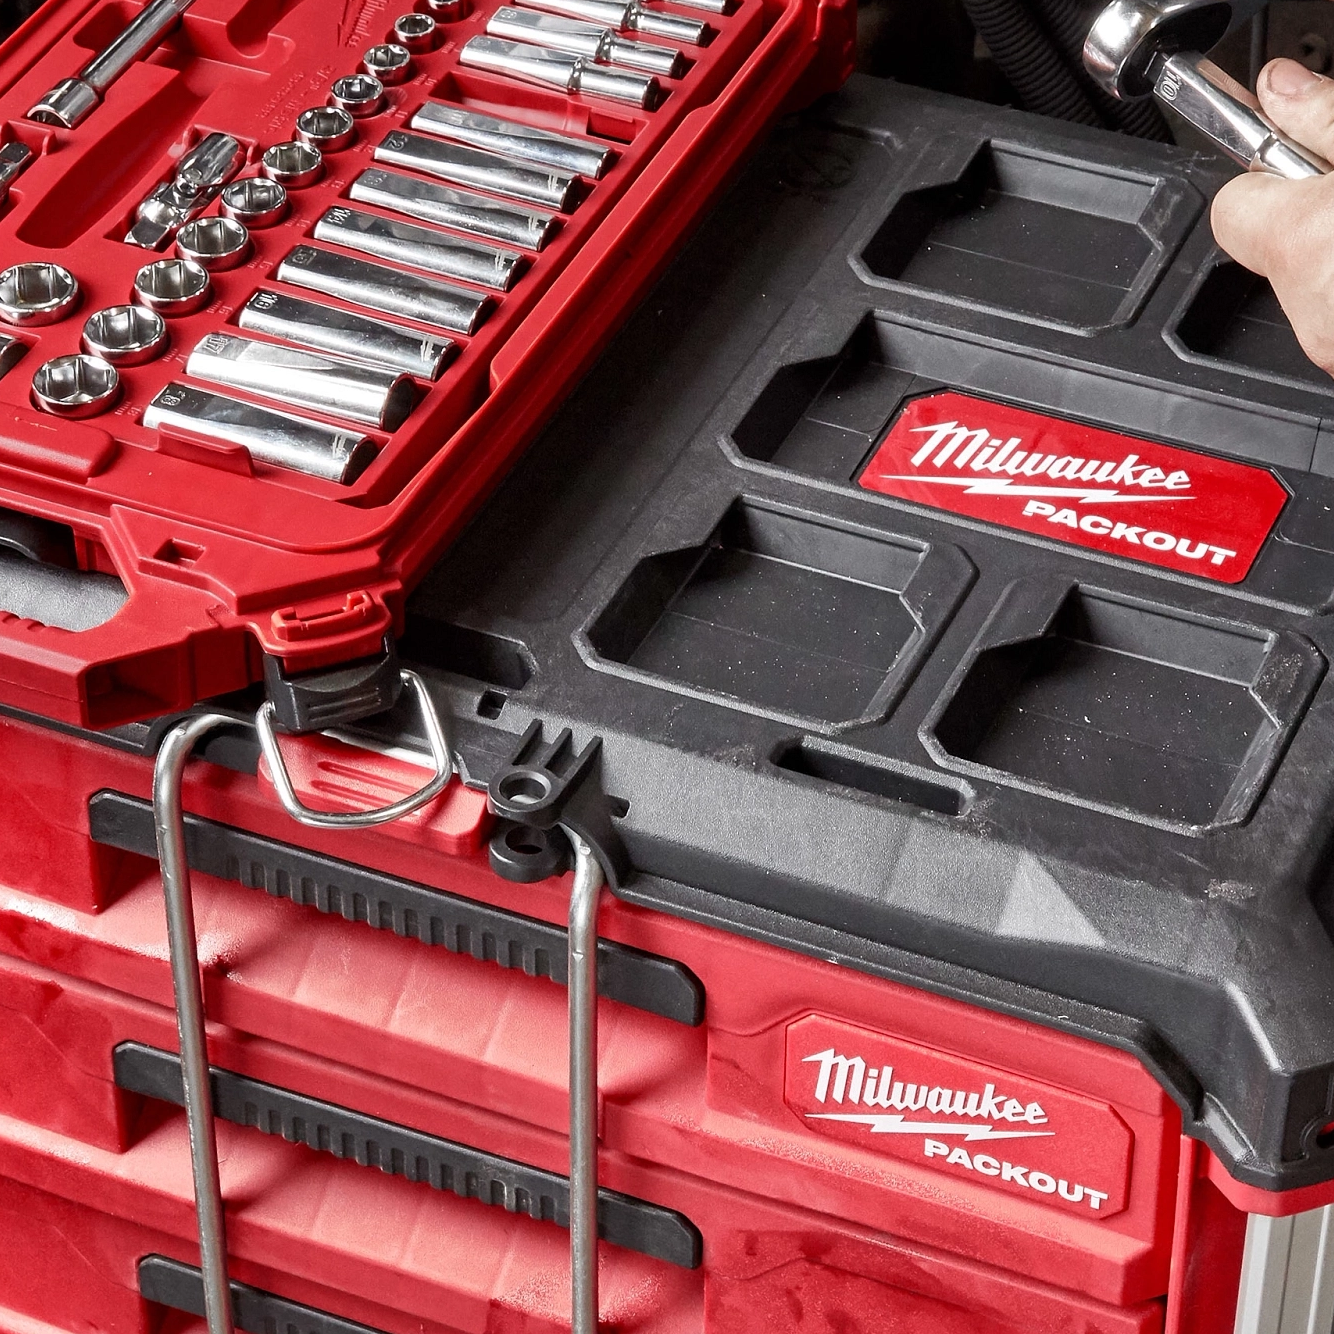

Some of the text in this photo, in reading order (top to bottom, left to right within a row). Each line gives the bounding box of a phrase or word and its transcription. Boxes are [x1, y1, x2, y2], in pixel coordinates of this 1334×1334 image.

[908, 420, 1193, 491] Milwaukee
[1022, 499, 1238, 567] PACKOUT
[801, 1047, 1050, 1125] Milwaukee
[923, 1138, 1110, 1211] PACKOUT
